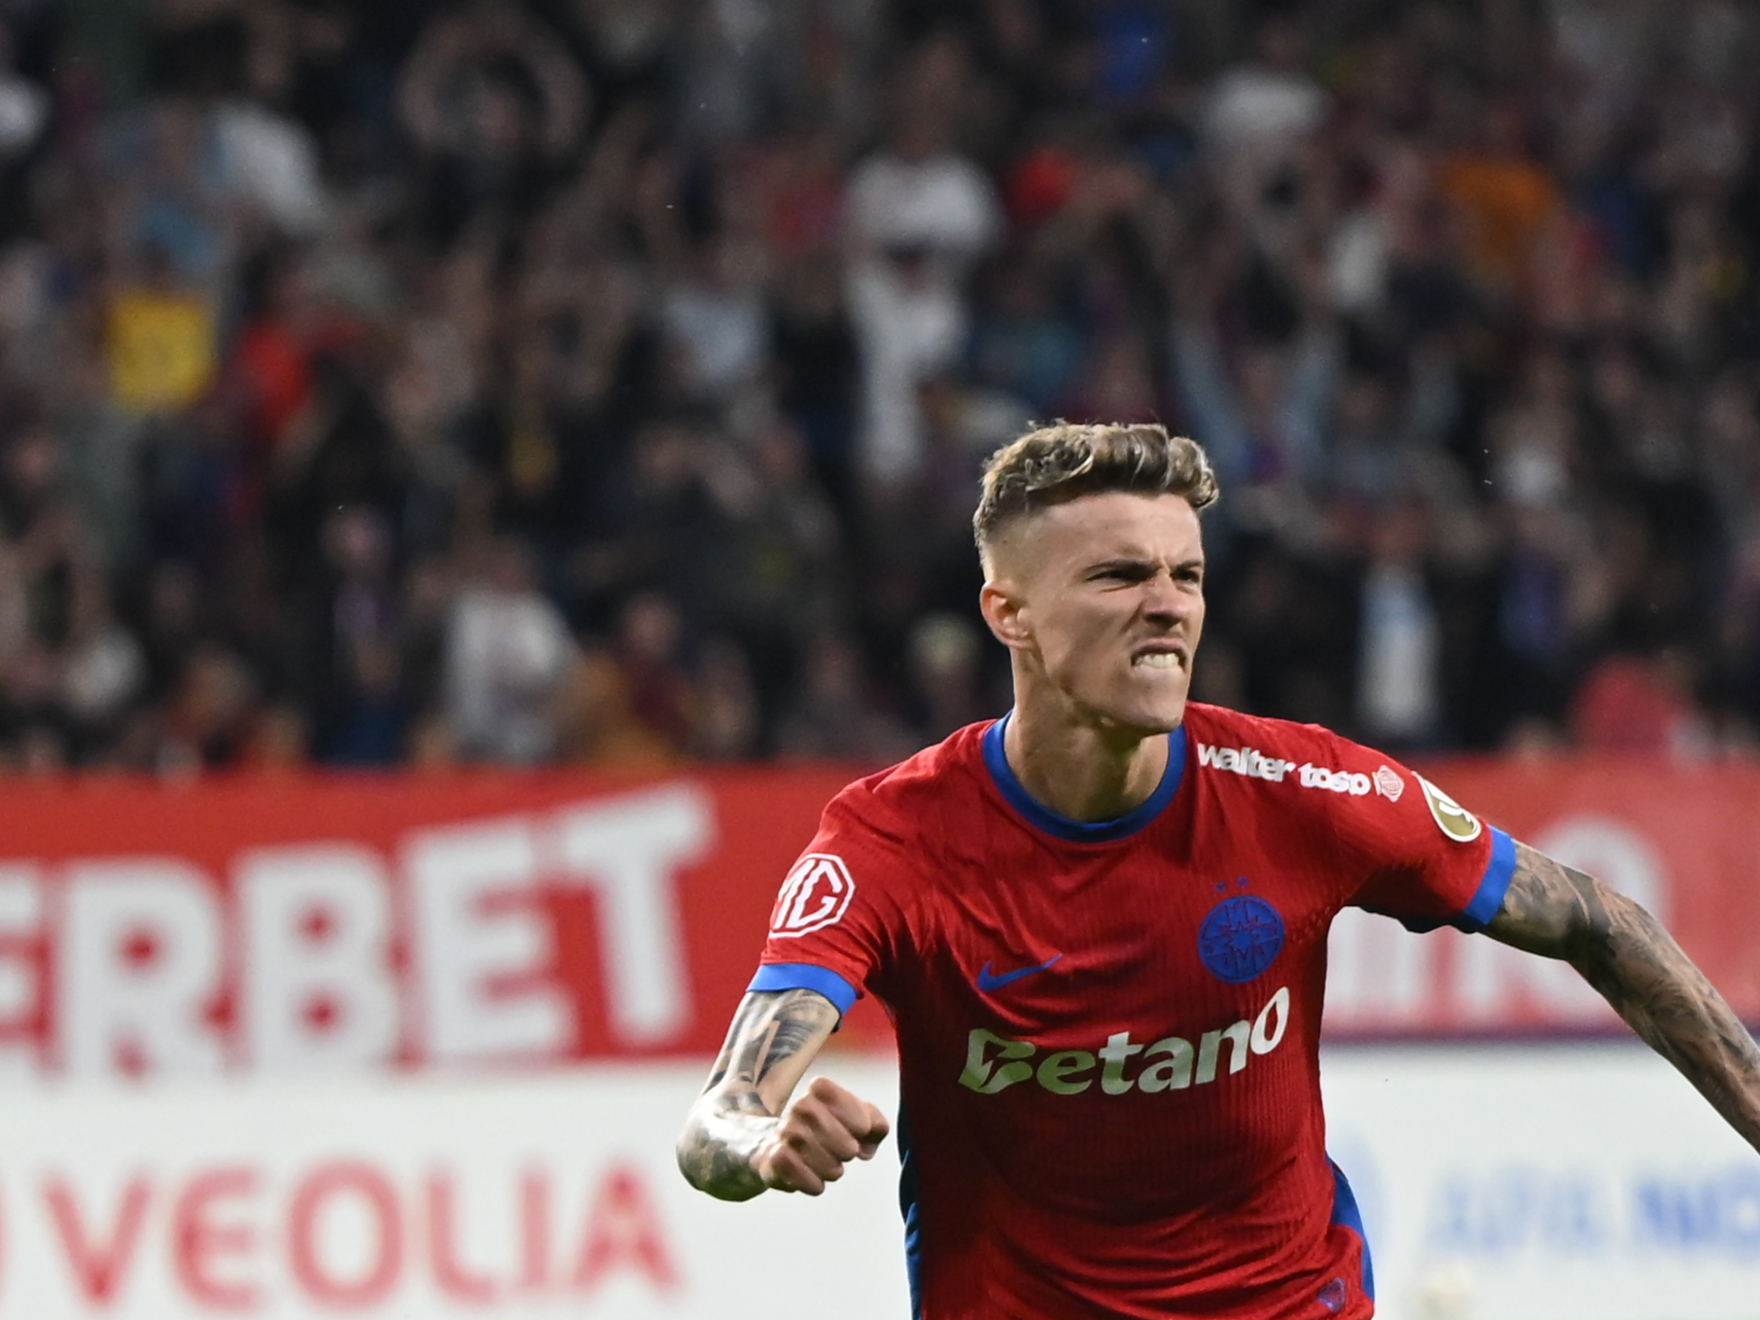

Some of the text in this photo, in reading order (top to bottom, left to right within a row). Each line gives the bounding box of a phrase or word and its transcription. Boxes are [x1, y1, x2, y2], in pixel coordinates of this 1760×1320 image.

[1197, 742, 1373, 796] walter toso
[958, 986, 1290, 1095] Betano
[38, 1154, 684, 1316] VEOLIA
